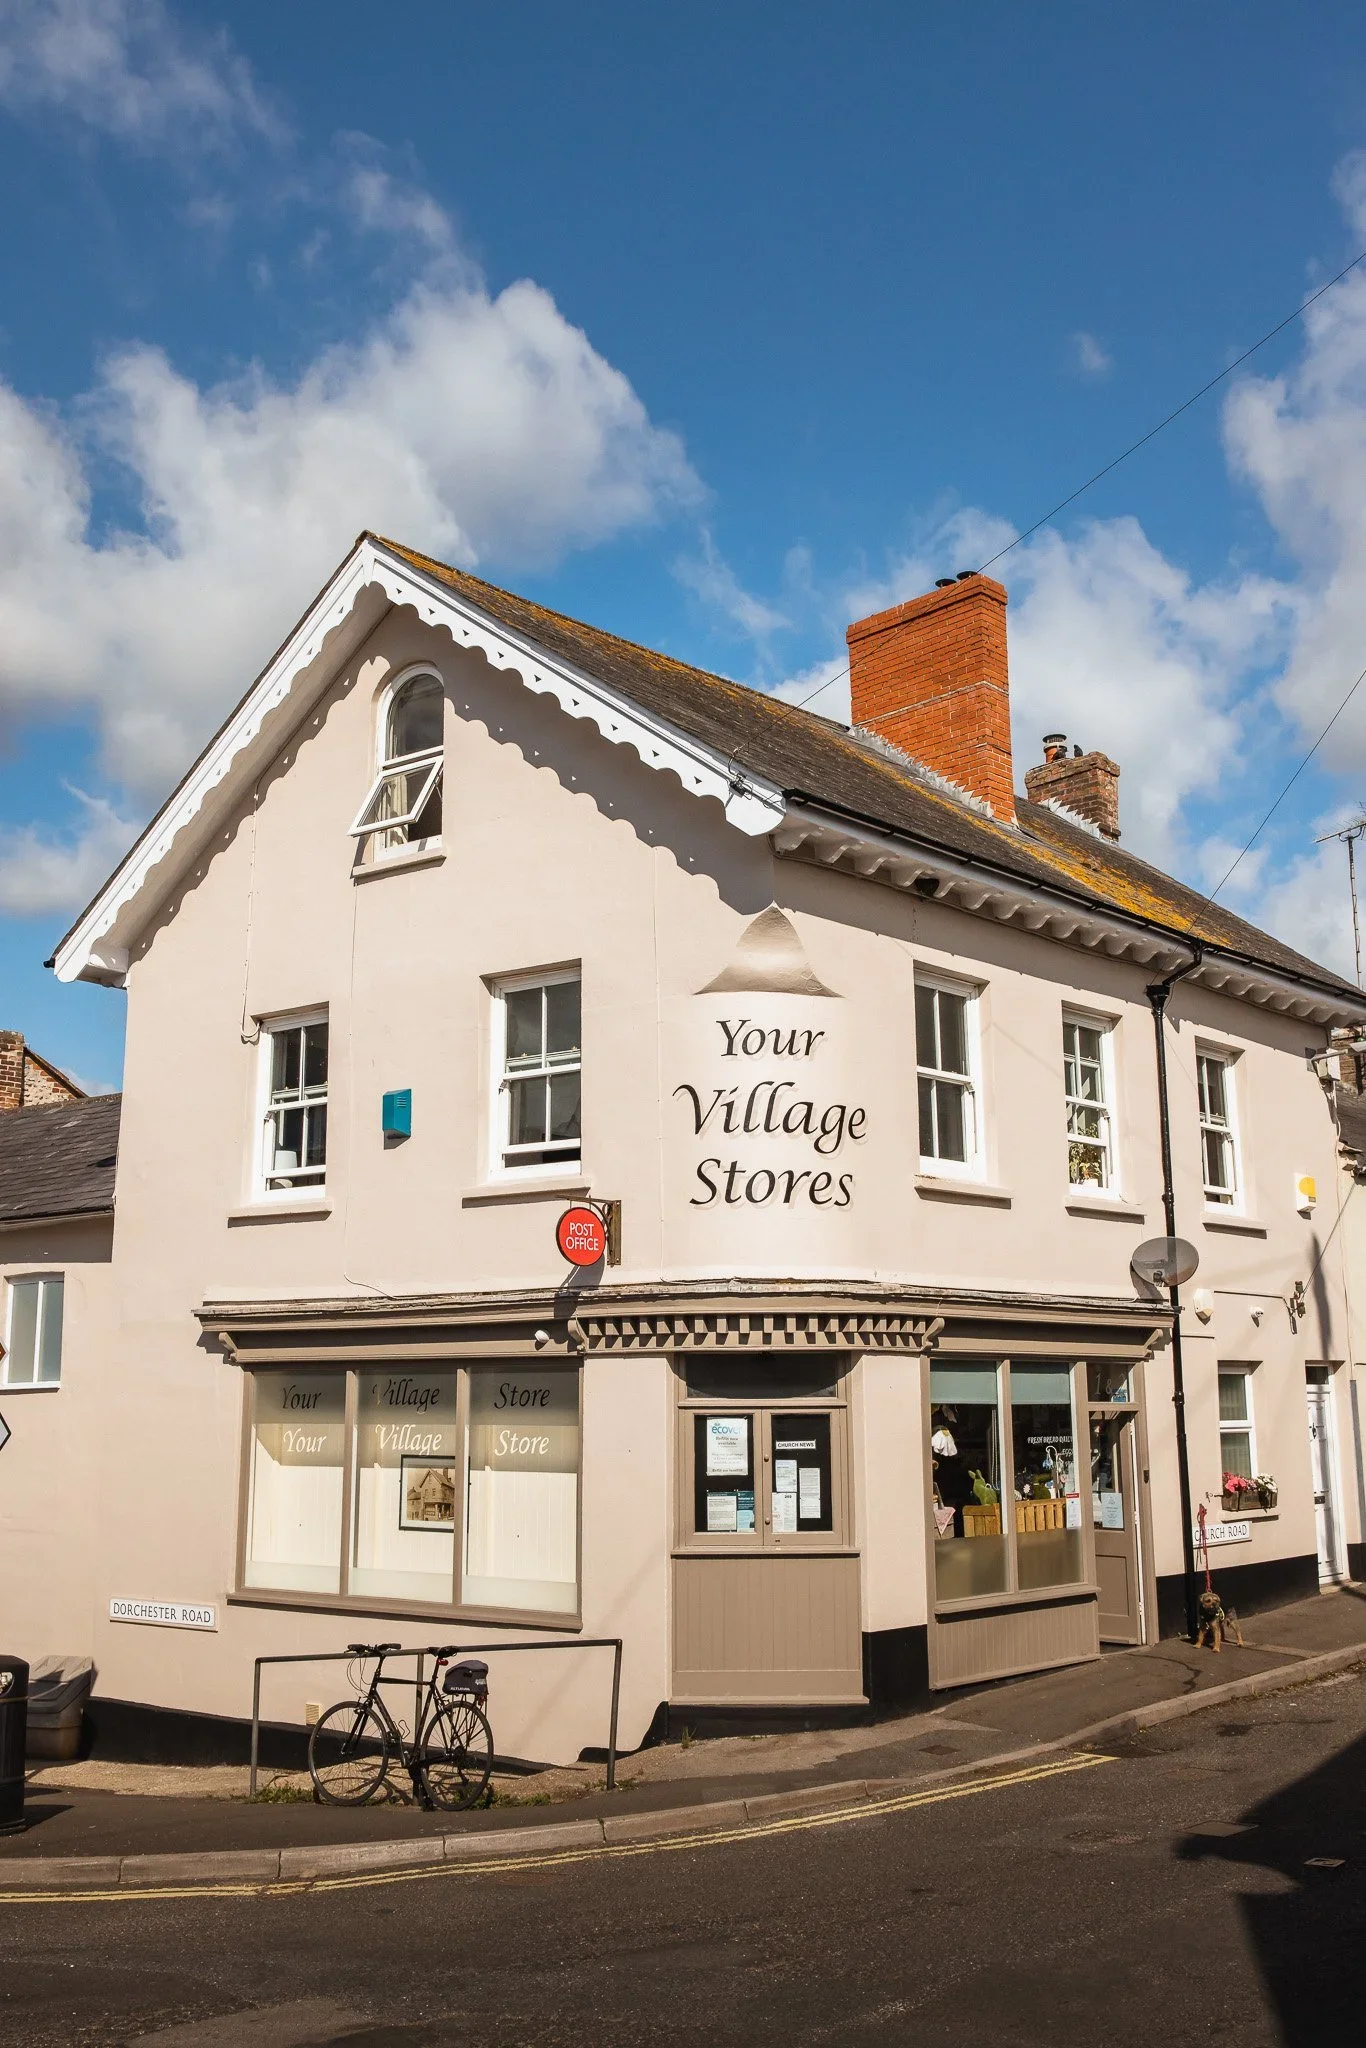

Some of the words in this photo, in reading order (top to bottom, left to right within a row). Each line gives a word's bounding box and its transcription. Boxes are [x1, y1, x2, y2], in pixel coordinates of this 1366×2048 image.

[715, 1019, 825, 1057] Your
[672, 1080, 867, 1154] Village
[689, 1158, 853, 1207] Stores
[565, 1236, 599, 1251] OFFICE
[569, 1222, 595, 1237] POST
[282, 1384, 322, 1410] Your
[494, 1382, 550, 1410] Store
[283, 1428, 327, 1453] Your
[375, 1424, 442, 1455] Village
[494, 1430, 549, 1456] Store
[1194, 1527, 1225, 1542] CURCH
[1228, 1524, 1247, 1538] ROAD
[113, 1602, 177, 1620] DORCHESTER
[182, 1609, 211, 1623] ROAD
